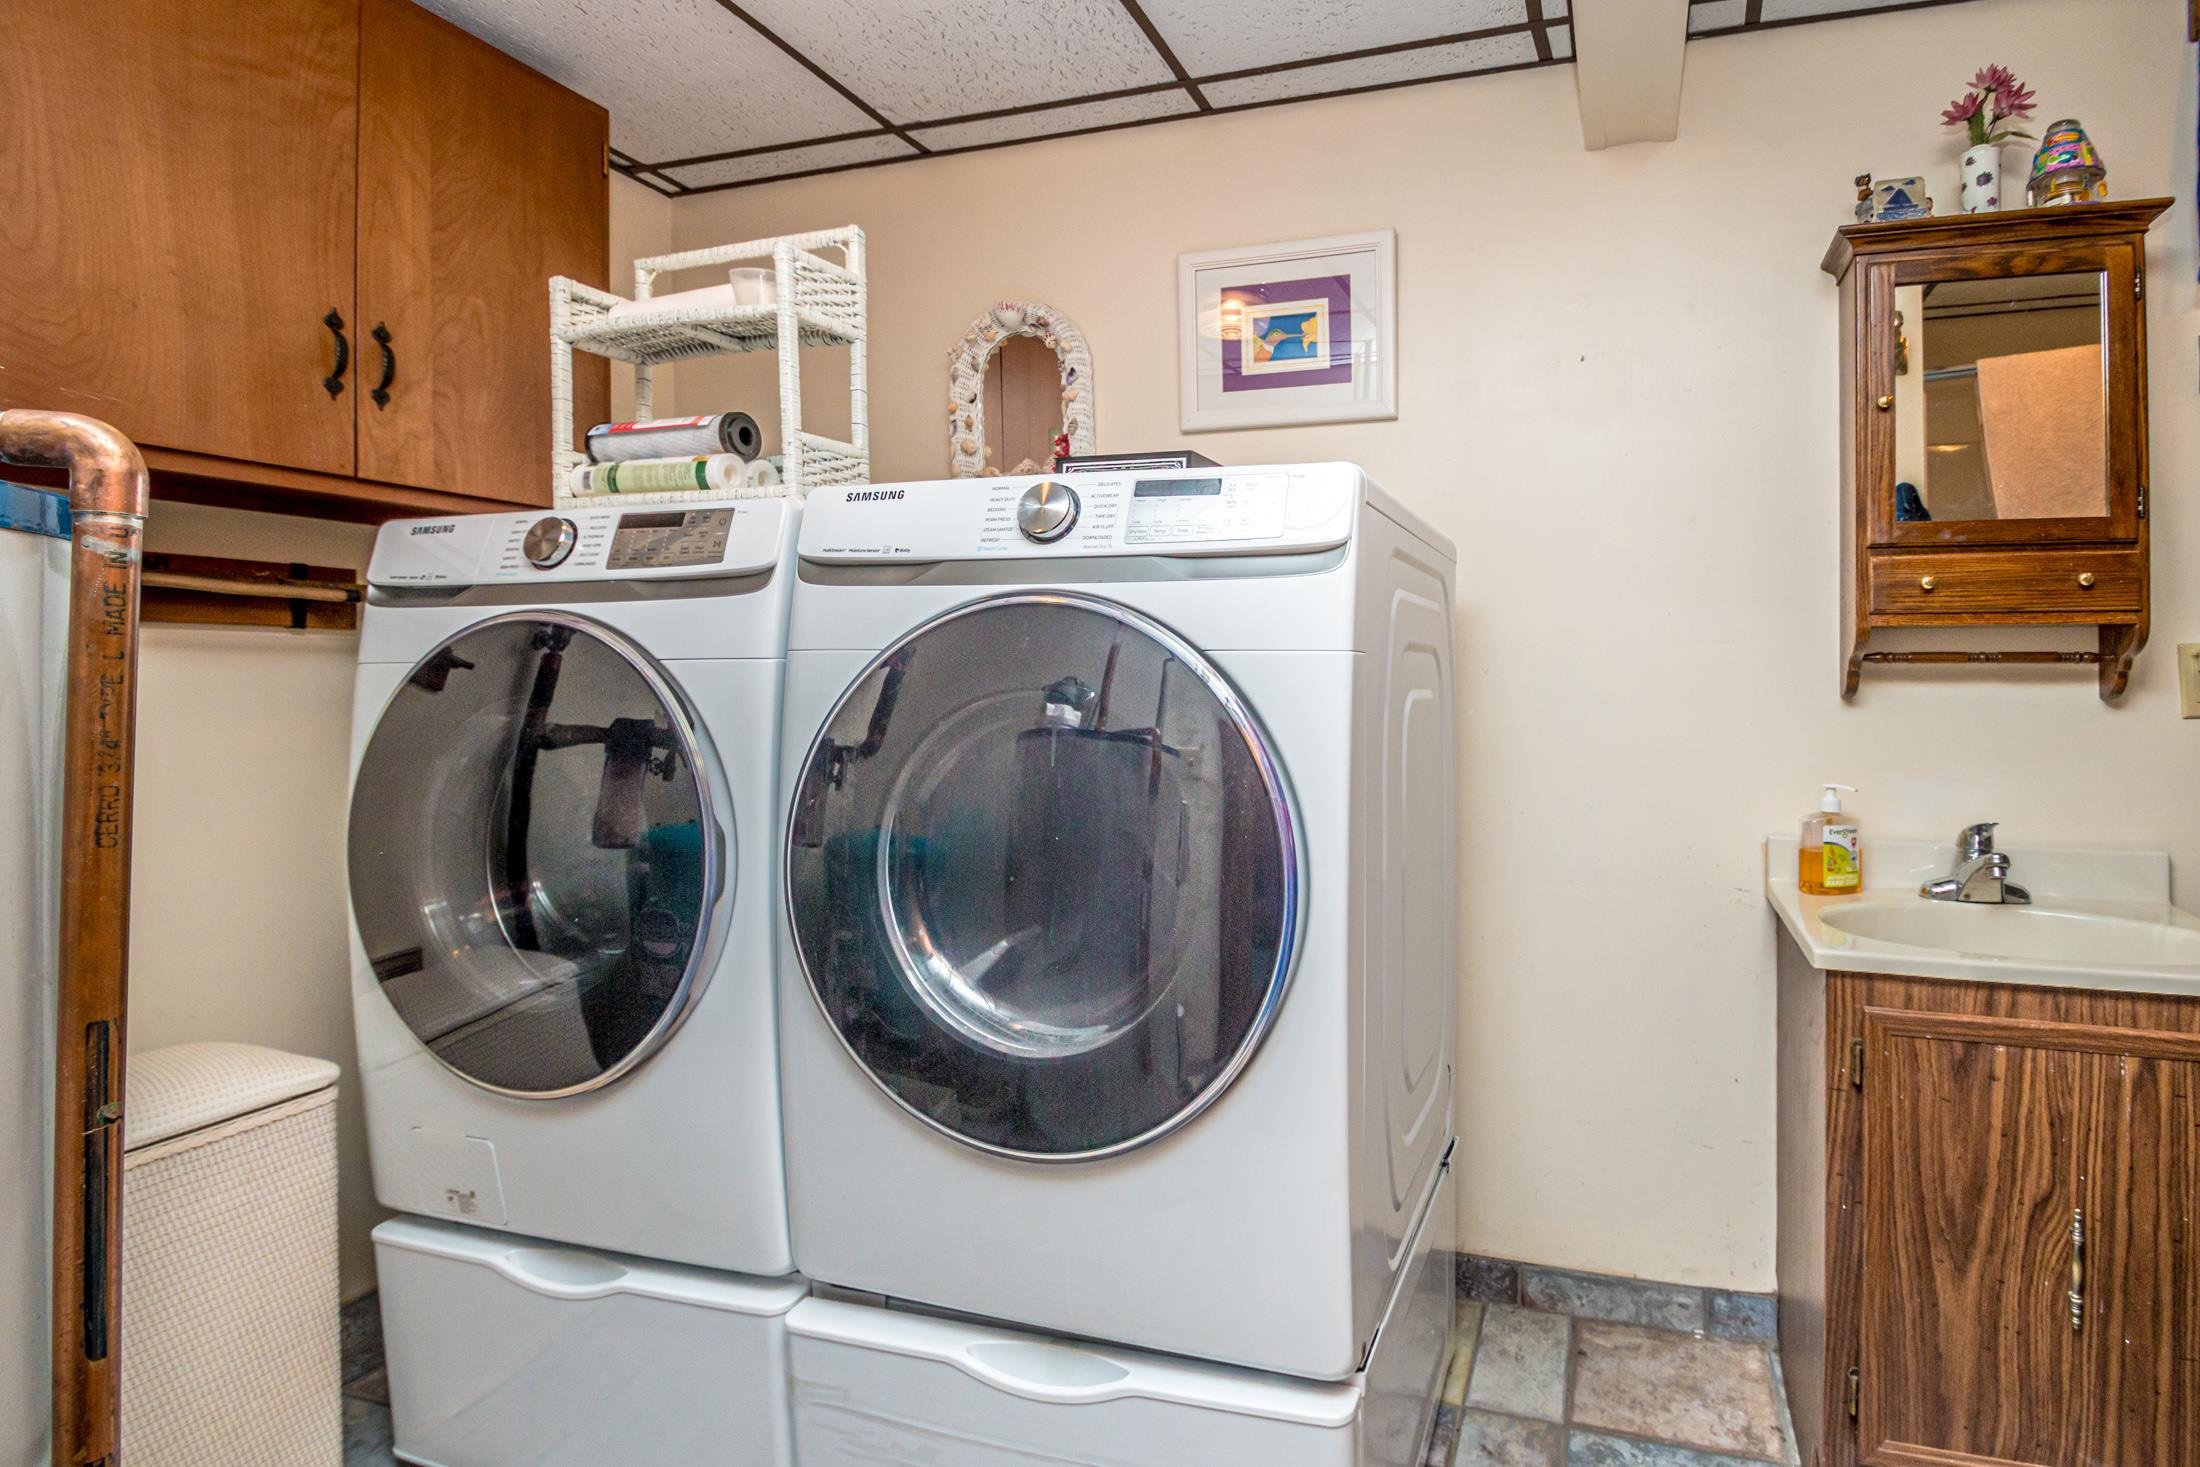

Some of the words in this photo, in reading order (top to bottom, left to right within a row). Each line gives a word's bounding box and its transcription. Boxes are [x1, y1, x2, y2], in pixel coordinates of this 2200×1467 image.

[846, 490, 905, 502] SAMSUNG
[411, 524, 456, 535] SAMSUNG
[103, 551, 128, 570] IN
[102, 581, 127, 636] MADE
[94, 785, 120, 849] CERRO
